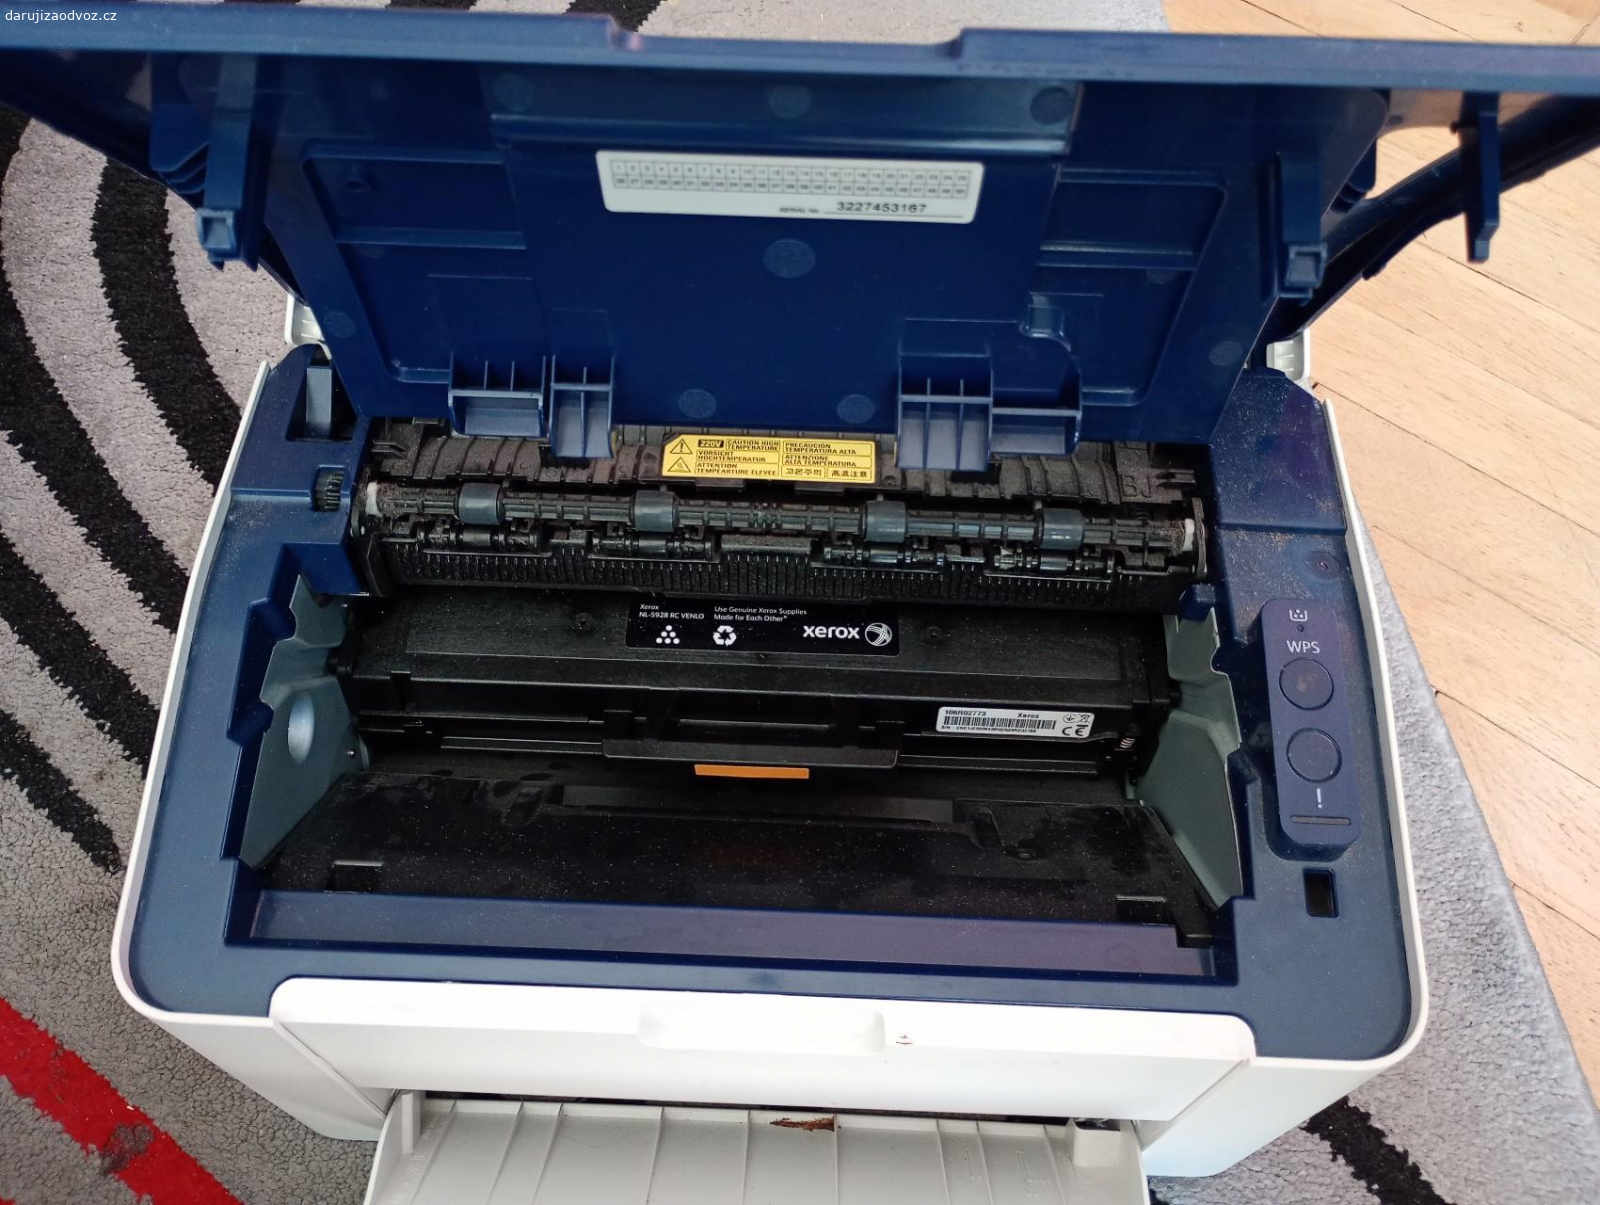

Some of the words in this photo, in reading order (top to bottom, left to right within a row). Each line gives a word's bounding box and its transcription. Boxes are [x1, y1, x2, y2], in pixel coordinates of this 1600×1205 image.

[837, 201, 927, 214] 3227453167
[699, 440, 722, 448] 220V
[639, 611, 669, 619] NL-5928
[778, 607, 807, 616] Supplies
[802, 625, 860, 639] xerox
[1286, 640, 1321, 654] WPS
